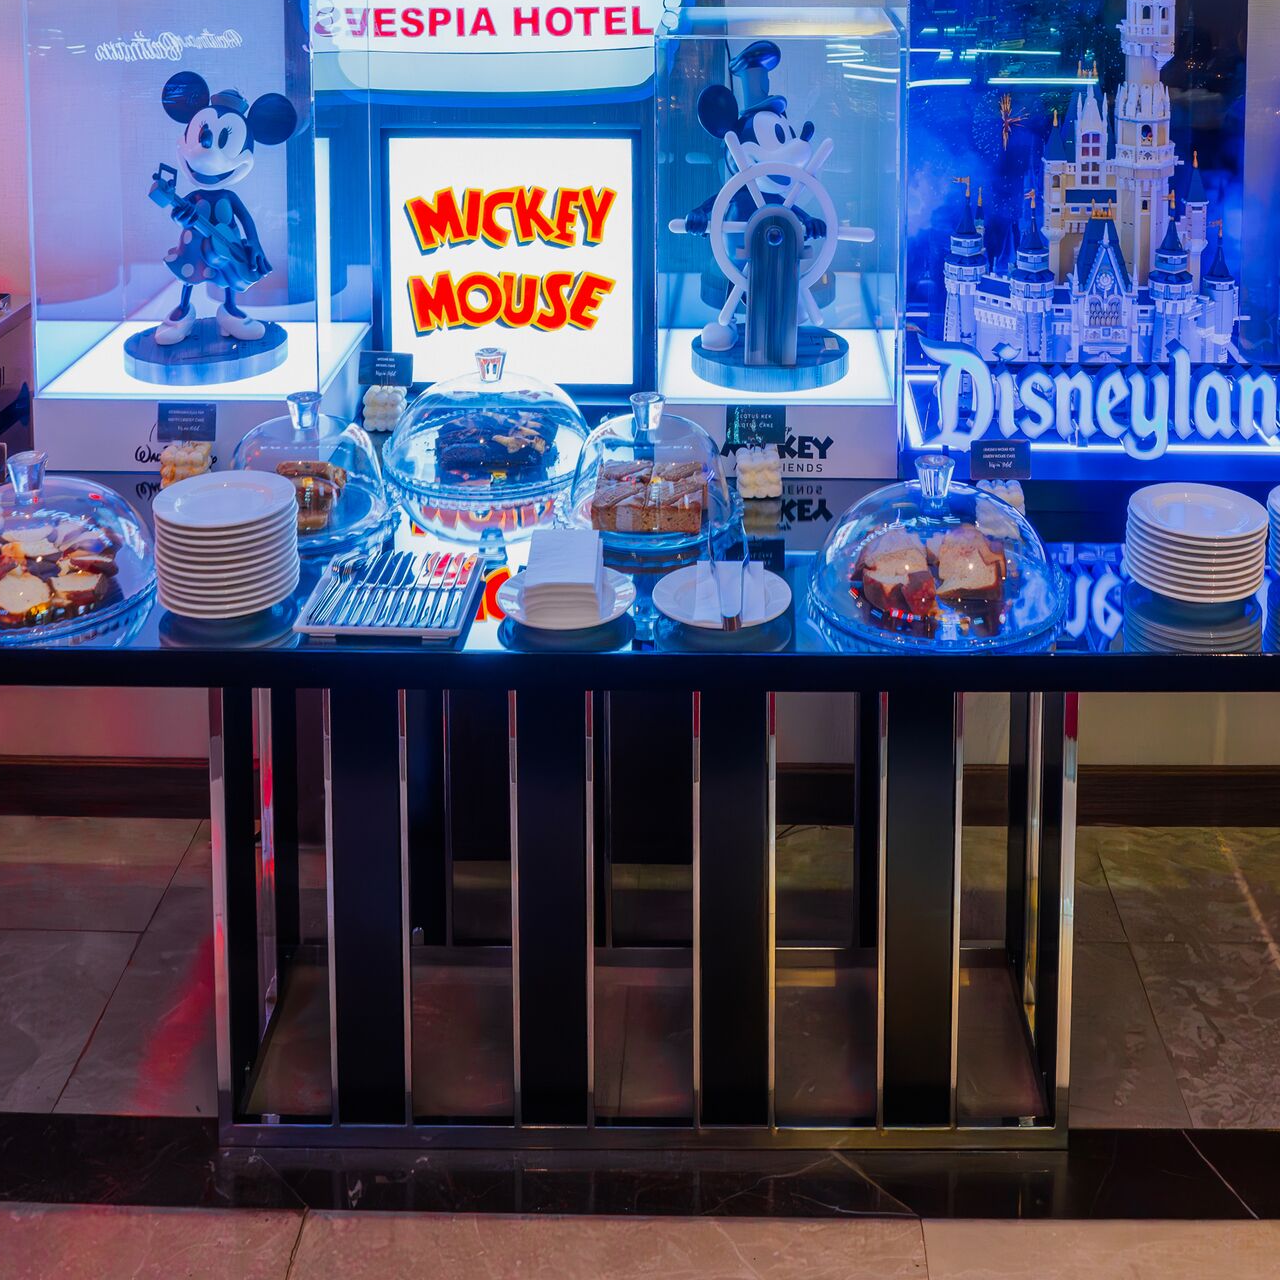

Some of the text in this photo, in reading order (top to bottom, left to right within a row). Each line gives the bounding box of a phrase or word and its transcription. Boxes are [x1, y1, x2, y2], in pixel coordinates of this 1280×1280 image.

[513, 5, 655, 37] HOTEL
[403, 185, 618, 256] MICKEY
[407, 271, 617, 338] MOUSE
